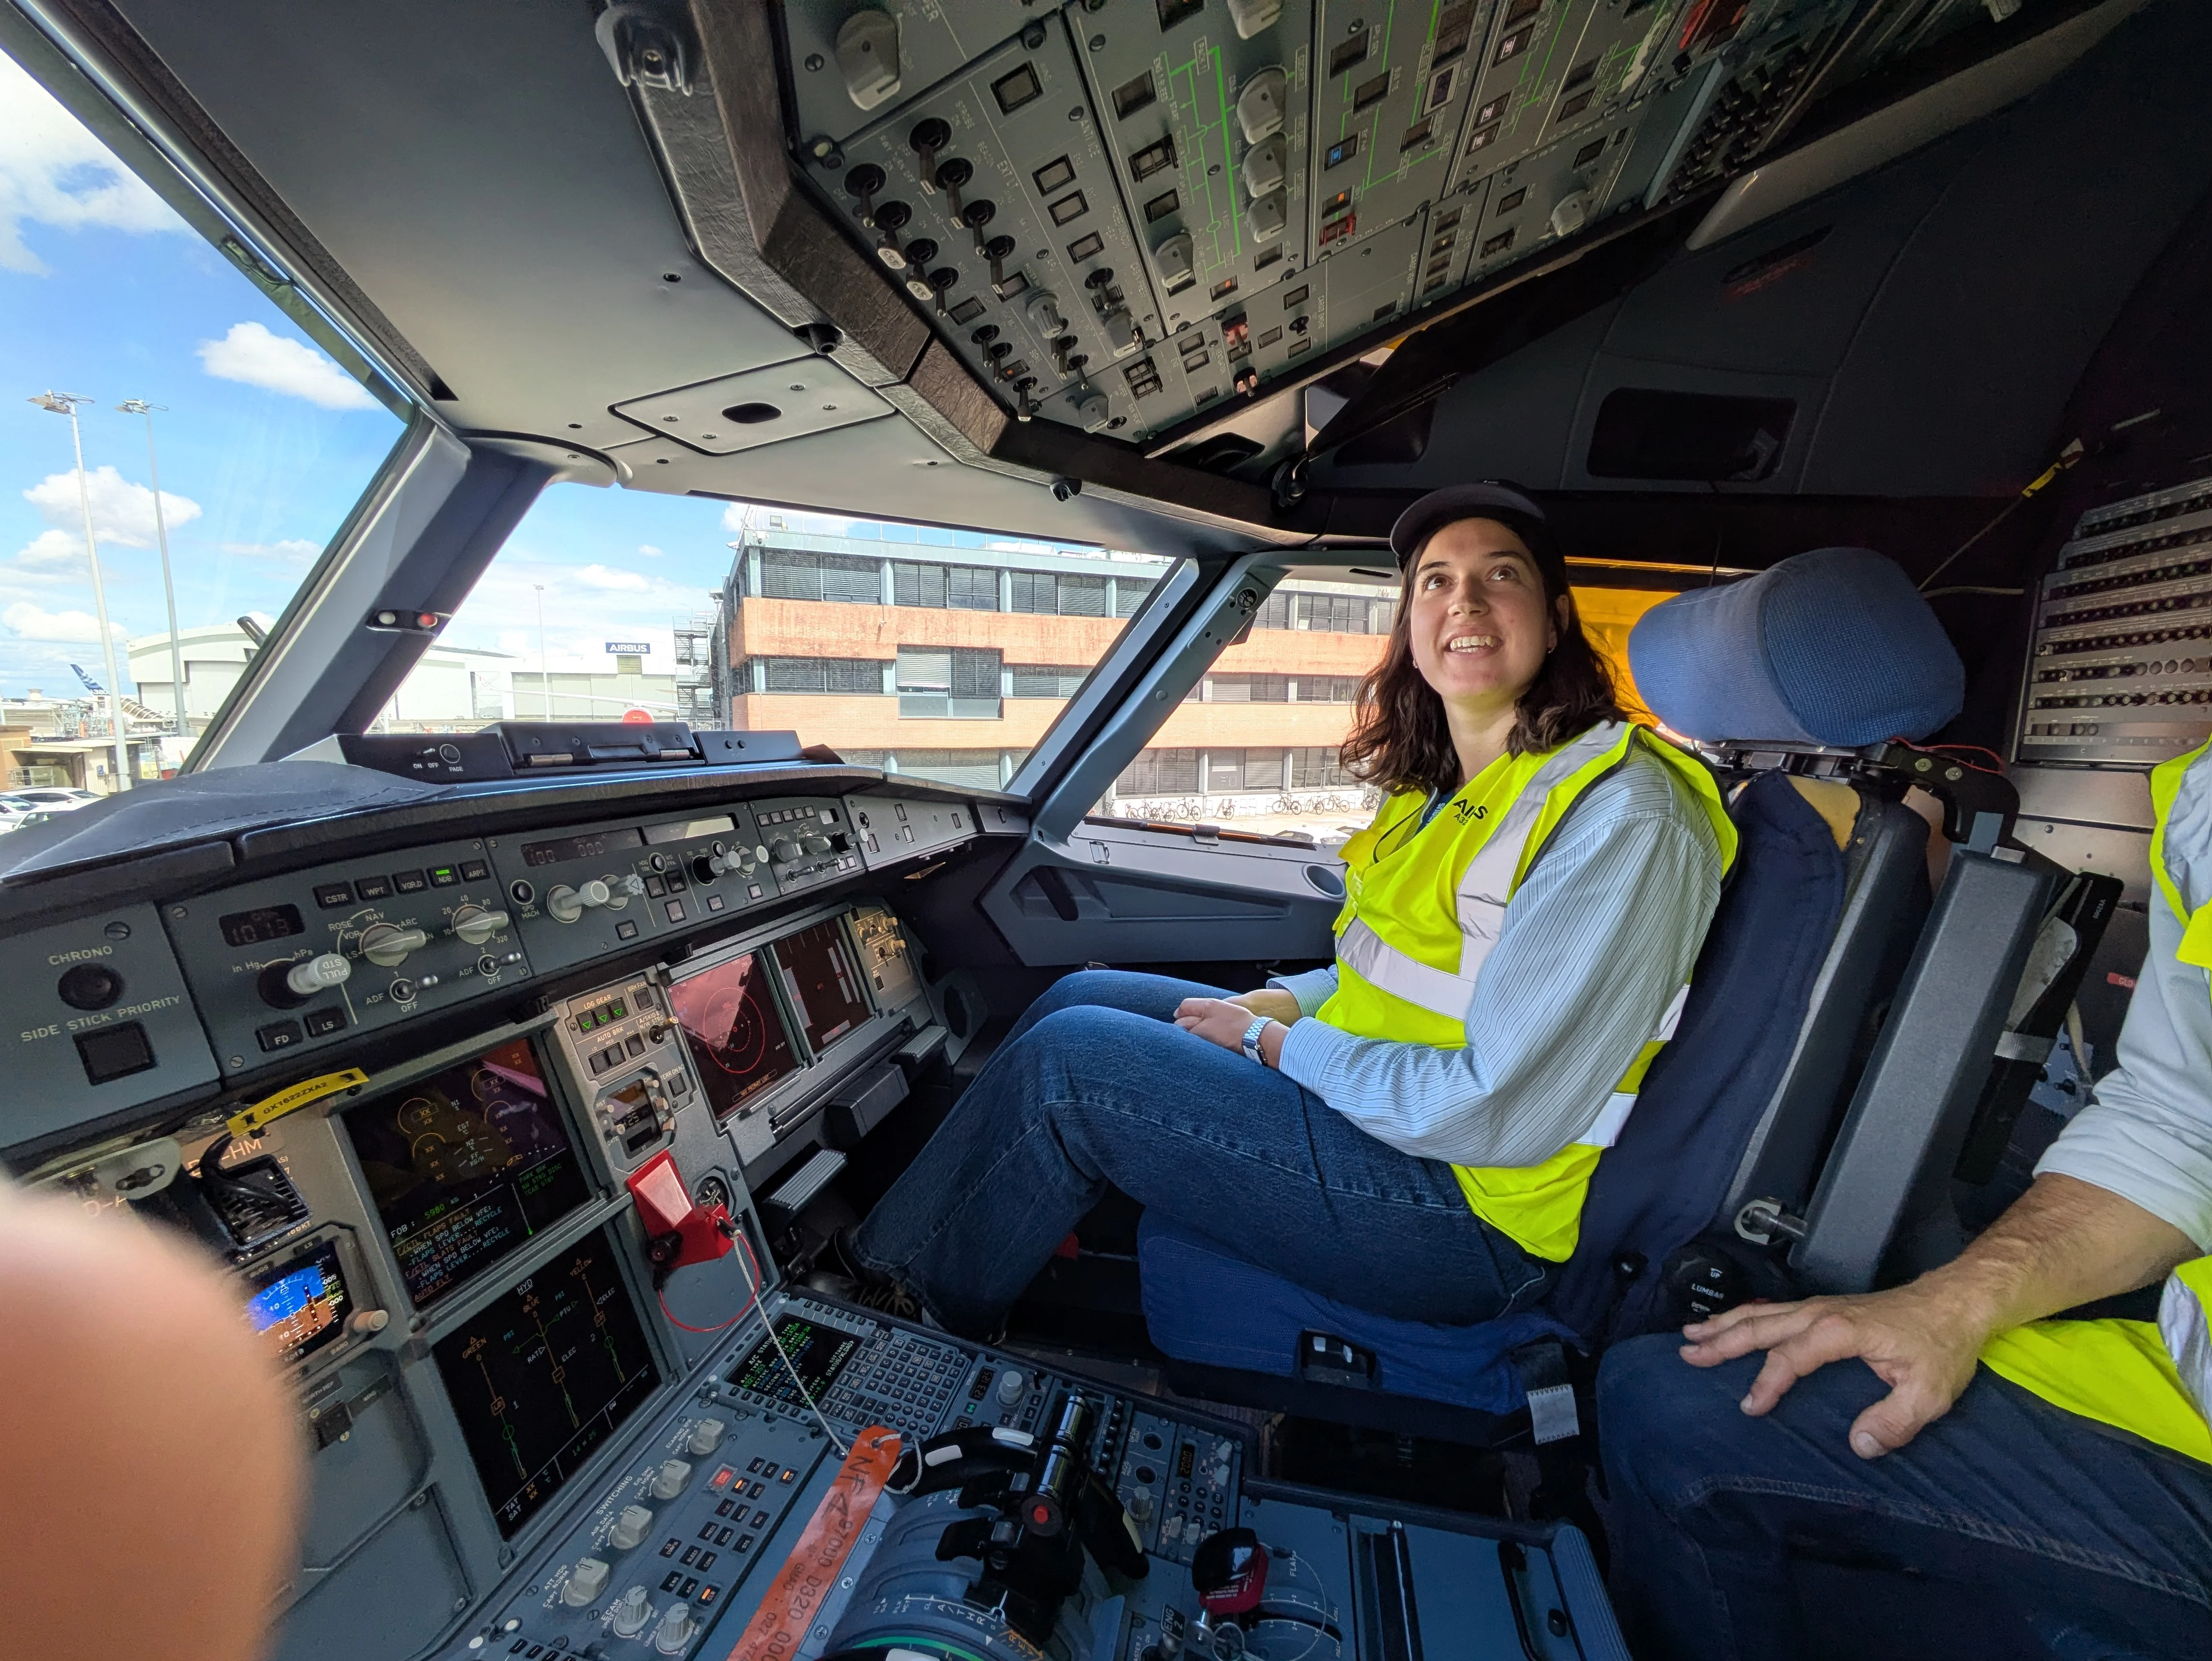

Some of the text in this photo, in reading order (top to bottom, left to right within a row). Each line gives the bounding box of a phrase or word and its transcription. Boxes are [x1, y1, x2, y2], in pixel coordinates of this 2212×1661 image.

[997, 160, 1013, 177] EXT
[609, 643, 647, 653] AIRBUS
[1453, 813, 1469, 825] A32
[438, 875, 452, 883] NDB
[468, 868, 485, 879] ARPT
[366, 887, 384, 896] WPT
[325, 893, 348, 904] CSTR
[482, 898, 491, 907] 80
[365, 912, 385, 922] NAV
[521, 910, 540, 919] MACH
[328, 919, 354, 931] ROSE
[400, 918, 418, 927] ARC
[343, 930, 360, 940] VOR
[496, 935, 509, 943] 320
[48, 945, 113, 966] CHRONO
[295, 947, 314, 958] hPa
[347, 951, 358, 960] LS
[245, 961, 260, 972] Hg
[322, 958, 342, 969] STD
[321, 968, 348, 980] PULL
[458, 966, 474, 978] ADF
[487, 975, 502, 984] OFF
[366, 994, 385, 1006] ADF
[597, 994, 612, 1005] GEAR
[400, 1001, 419, 1012] OFF
[20, 995, 182, 1042] SIDE STICK PRIORITY
[640, 1015, 664, 1030] N/W STRG
[321, 1020, 334, 1031] LS
[274, 1034, 290, 1045] FD
[597, 1026, 624, 1043] AUTO BRK
[661, 1072, 672, 1080] TERR
[263, 1081, 329, 1116] GX1622ZXA2
[457, 1121, 470, 1131] EGT
[607, 1136, 619, 1146] DATE
[470, 1152, 479, 1160] FF
[519, 1171, 534, 1183] PARK
[390, 1223, 408, 1239] FOB
[424, 1203, 445, 1220] 5980
[423, 1222, 446, 1240] FLAPS
[435, 1230, 449, 1241] SPD
[452, 1215, 474, 1232] BELOW
[432, 1244, 454, 1262] SLATS
[443, 1251, 457, 1263] SPD
[460, 1238, 482, 1253] BELOW
[569, 1259, 594, 1277] YELLOW
[517, 1278, 534, 1296] HYD
[1692, 1283, 1724, 1300] LUMBAR
[601, 1287, 616, 1301] ELEC
[559, 1305, 572, 1318] PTU
[503, 1329, 515, 1340] PSI
[462, 1337, 487, 1359] GREEN
[561, 1346, 577, 1362] ELEC
[748, 1336, 774, 1365] A/C STATUS
[829, 1341, 848, 1363] SOFTWARE
[527, 1350, 539, 1363] RAT
[750, 1359, 763, 1372] TYPE
[672, 1442, 684, 1455] CAPT
[754, 1462, 763, 1470] FUEL
[1181, 1450, 1192, 1474] 2000
[633, 1477, 643, 1486] EIS
[641, 1470, 655, 1484] NORM
[596, 1475, 633, 1516] SWITCHING
[634, 1486, 647, 1499] CAPT
[505, 1497, 520, 1513] TAT
[508, 1506, 522, 1522] SAT
[591, 1510, 614, 1536] AIR DATA
[600, 1517, 615, 1533] NORM
[706, 1525, 716, 1537] PRESS
[721, 1531, 730, 1543] DOOR
[591, 1534, 605, 1550] CAPT
[687, 1550, 698, 1562] BLEED
[704, 1556, 714, 1567] COND
[544, 1564, 567, 1590] ATT HDG
[552, 1570, 569, 1589] NORM
[669, 1577, 678, 1587] ENG
[782, 1562, 805, 1591] GMAO
[686, 1583, 695, 1593] APU
[542, 1590, 558, 1608] CAPT
[707, 1591, 716, 1601] CLR
[787, 1576, 822, 1620] D320
[600, 1599, 621, 1620] ECAM
[924, 1601, 932, 1610] CL
[937, 1604, 986, 1626] A/THR
[1163, 1608, 1183, 1631] ENG 2
[757, 1612, 777, 1636] 027
[1008, 1634, 1034, 1655] REV
